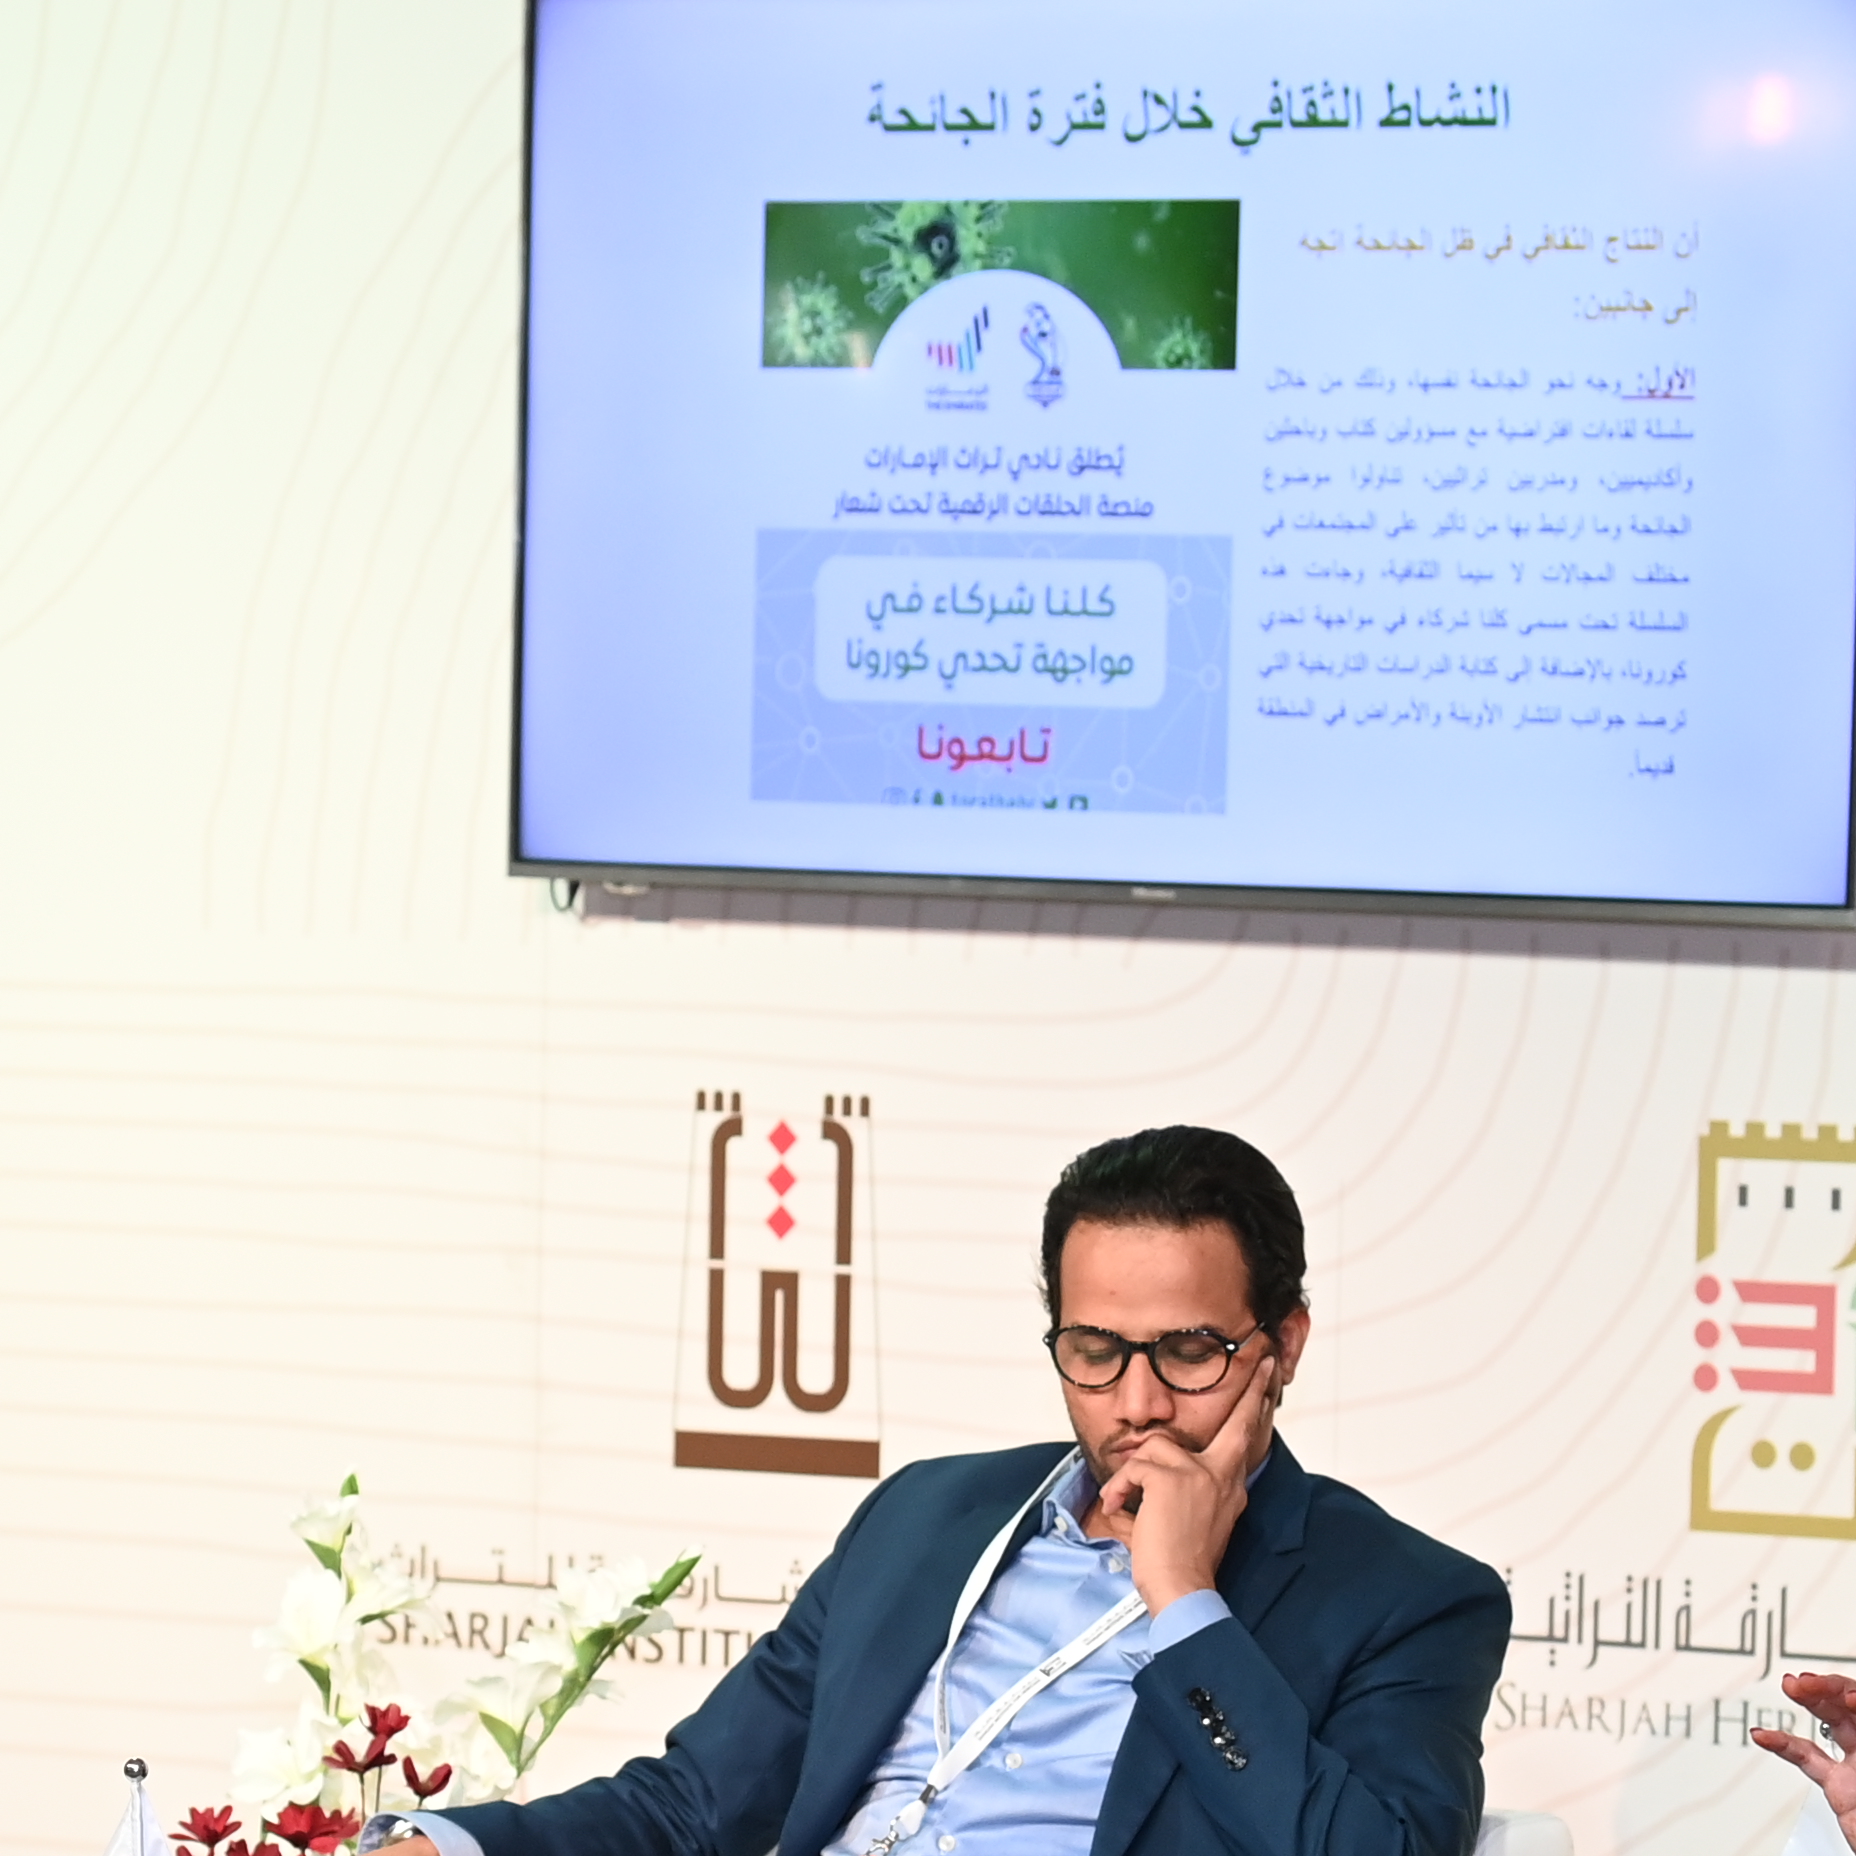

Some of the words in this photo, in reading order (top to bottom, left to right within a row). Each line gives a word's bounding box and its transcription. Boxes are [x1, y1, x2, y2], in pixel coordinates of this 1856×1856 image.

[867, 81, 1008, 147] الجائحة
[1026, 81, 1108, 148] فترة
[1122, 85, 1215, 144] خلال
[1230, 79, 1362, 155] الثقافي
[1379, 80, 1510, 129] النشاط
[953, 446, 1004, 477] تراث
[1008, 446, 1062, 481] نادي
[832, 490, 884, 520] شعار
[888, 490, 933, 517] تحت
[938, 491, 1011, 522] الرقمية
[1097, 492, 1155, 518] منصة
[865, 582, 924, 632] في
[933, 581, 1036, 625] شركاء
[1045, 583, 1116, 618] كلنا
[845, 637, 930, 681] كورونا
[937, 642, 1025, 691] تحدي
[1032, 642, 1135, 685] مواجهة
[916, 723, 1053, 774] تابعونا
[1493, 1682, 1693, 1743] SHARJAH
